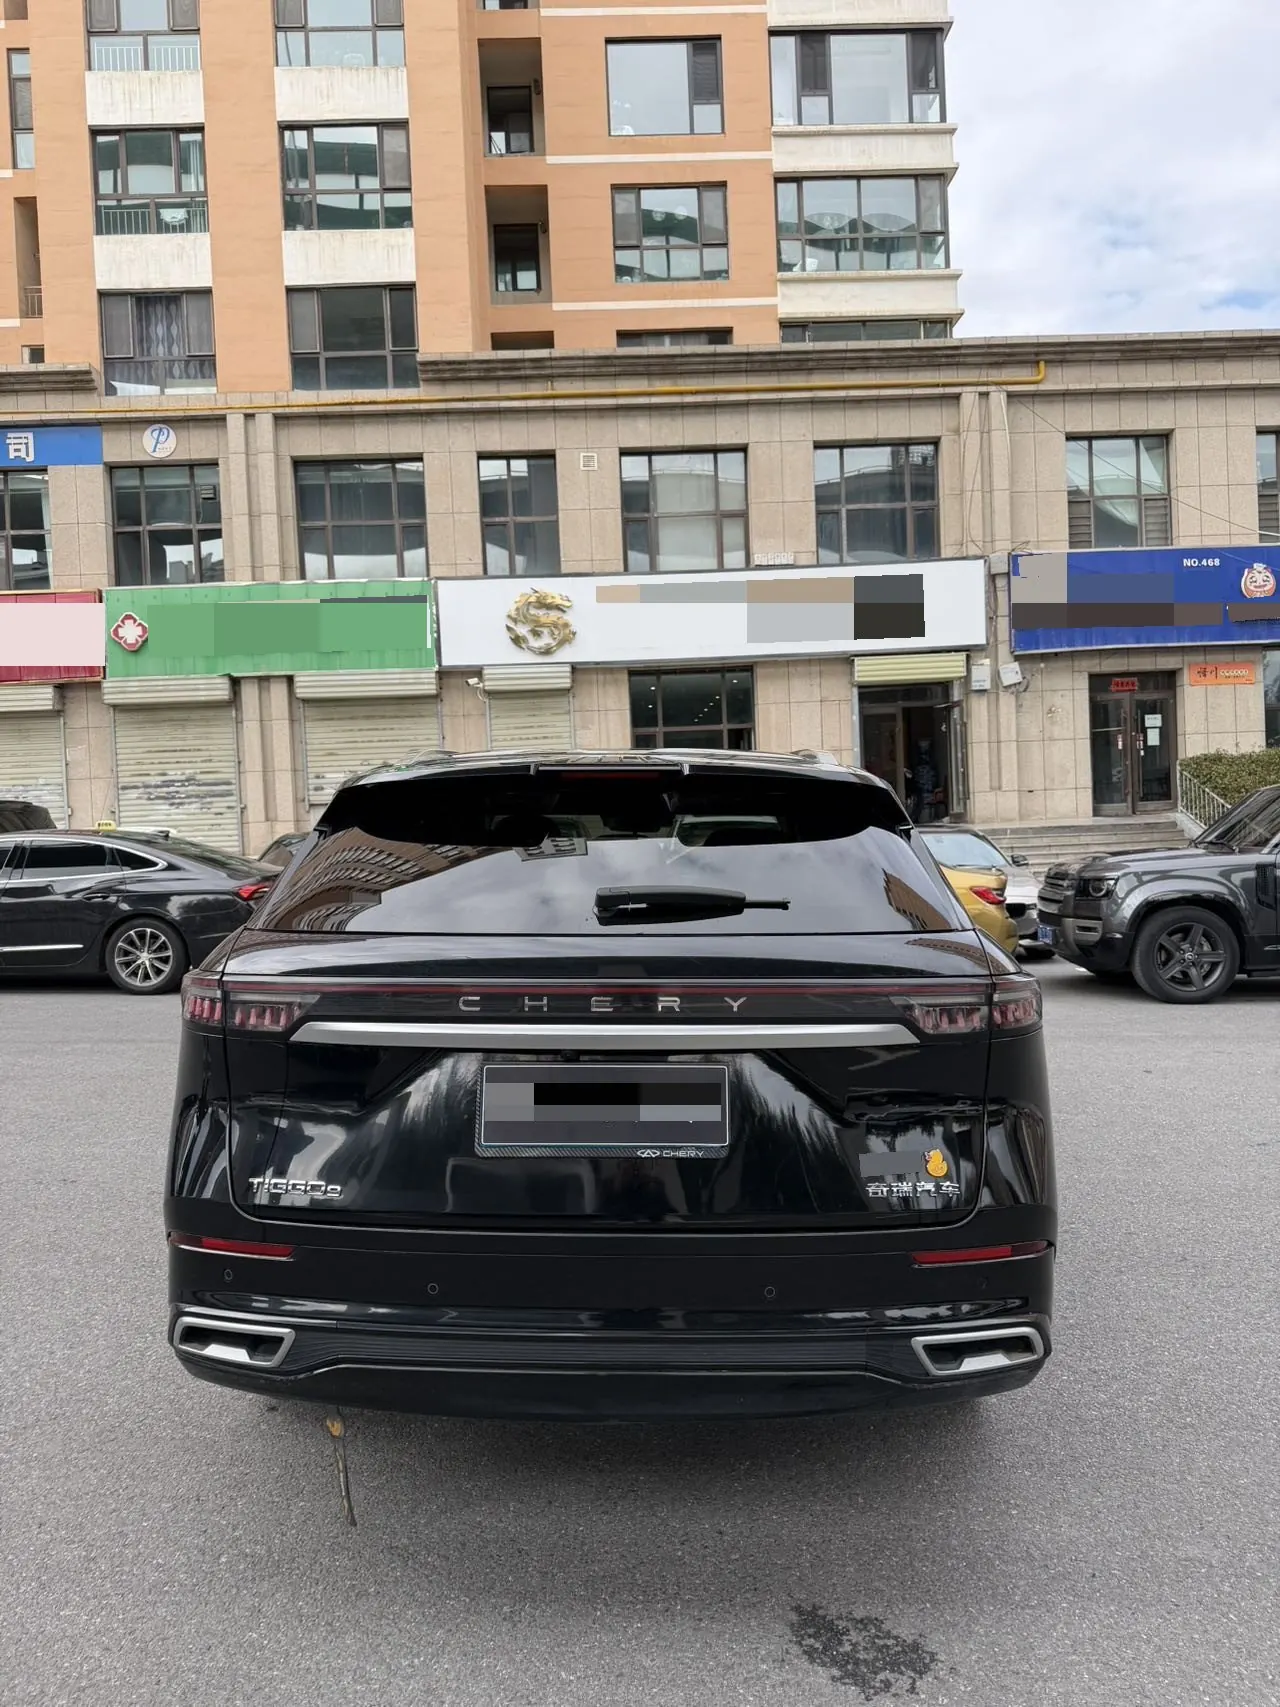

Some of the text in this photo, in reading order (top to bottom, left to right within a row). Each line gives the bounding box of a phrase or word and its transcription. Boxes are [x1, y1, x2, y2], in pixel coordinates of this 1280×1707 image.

[6, 432, 34, 462] 司
[1183, 558, 1221, 567] NO.468
[458, 996, 747, 1012] CHERY
[865, 1181, 960, 1198] 奇瑞汽车
